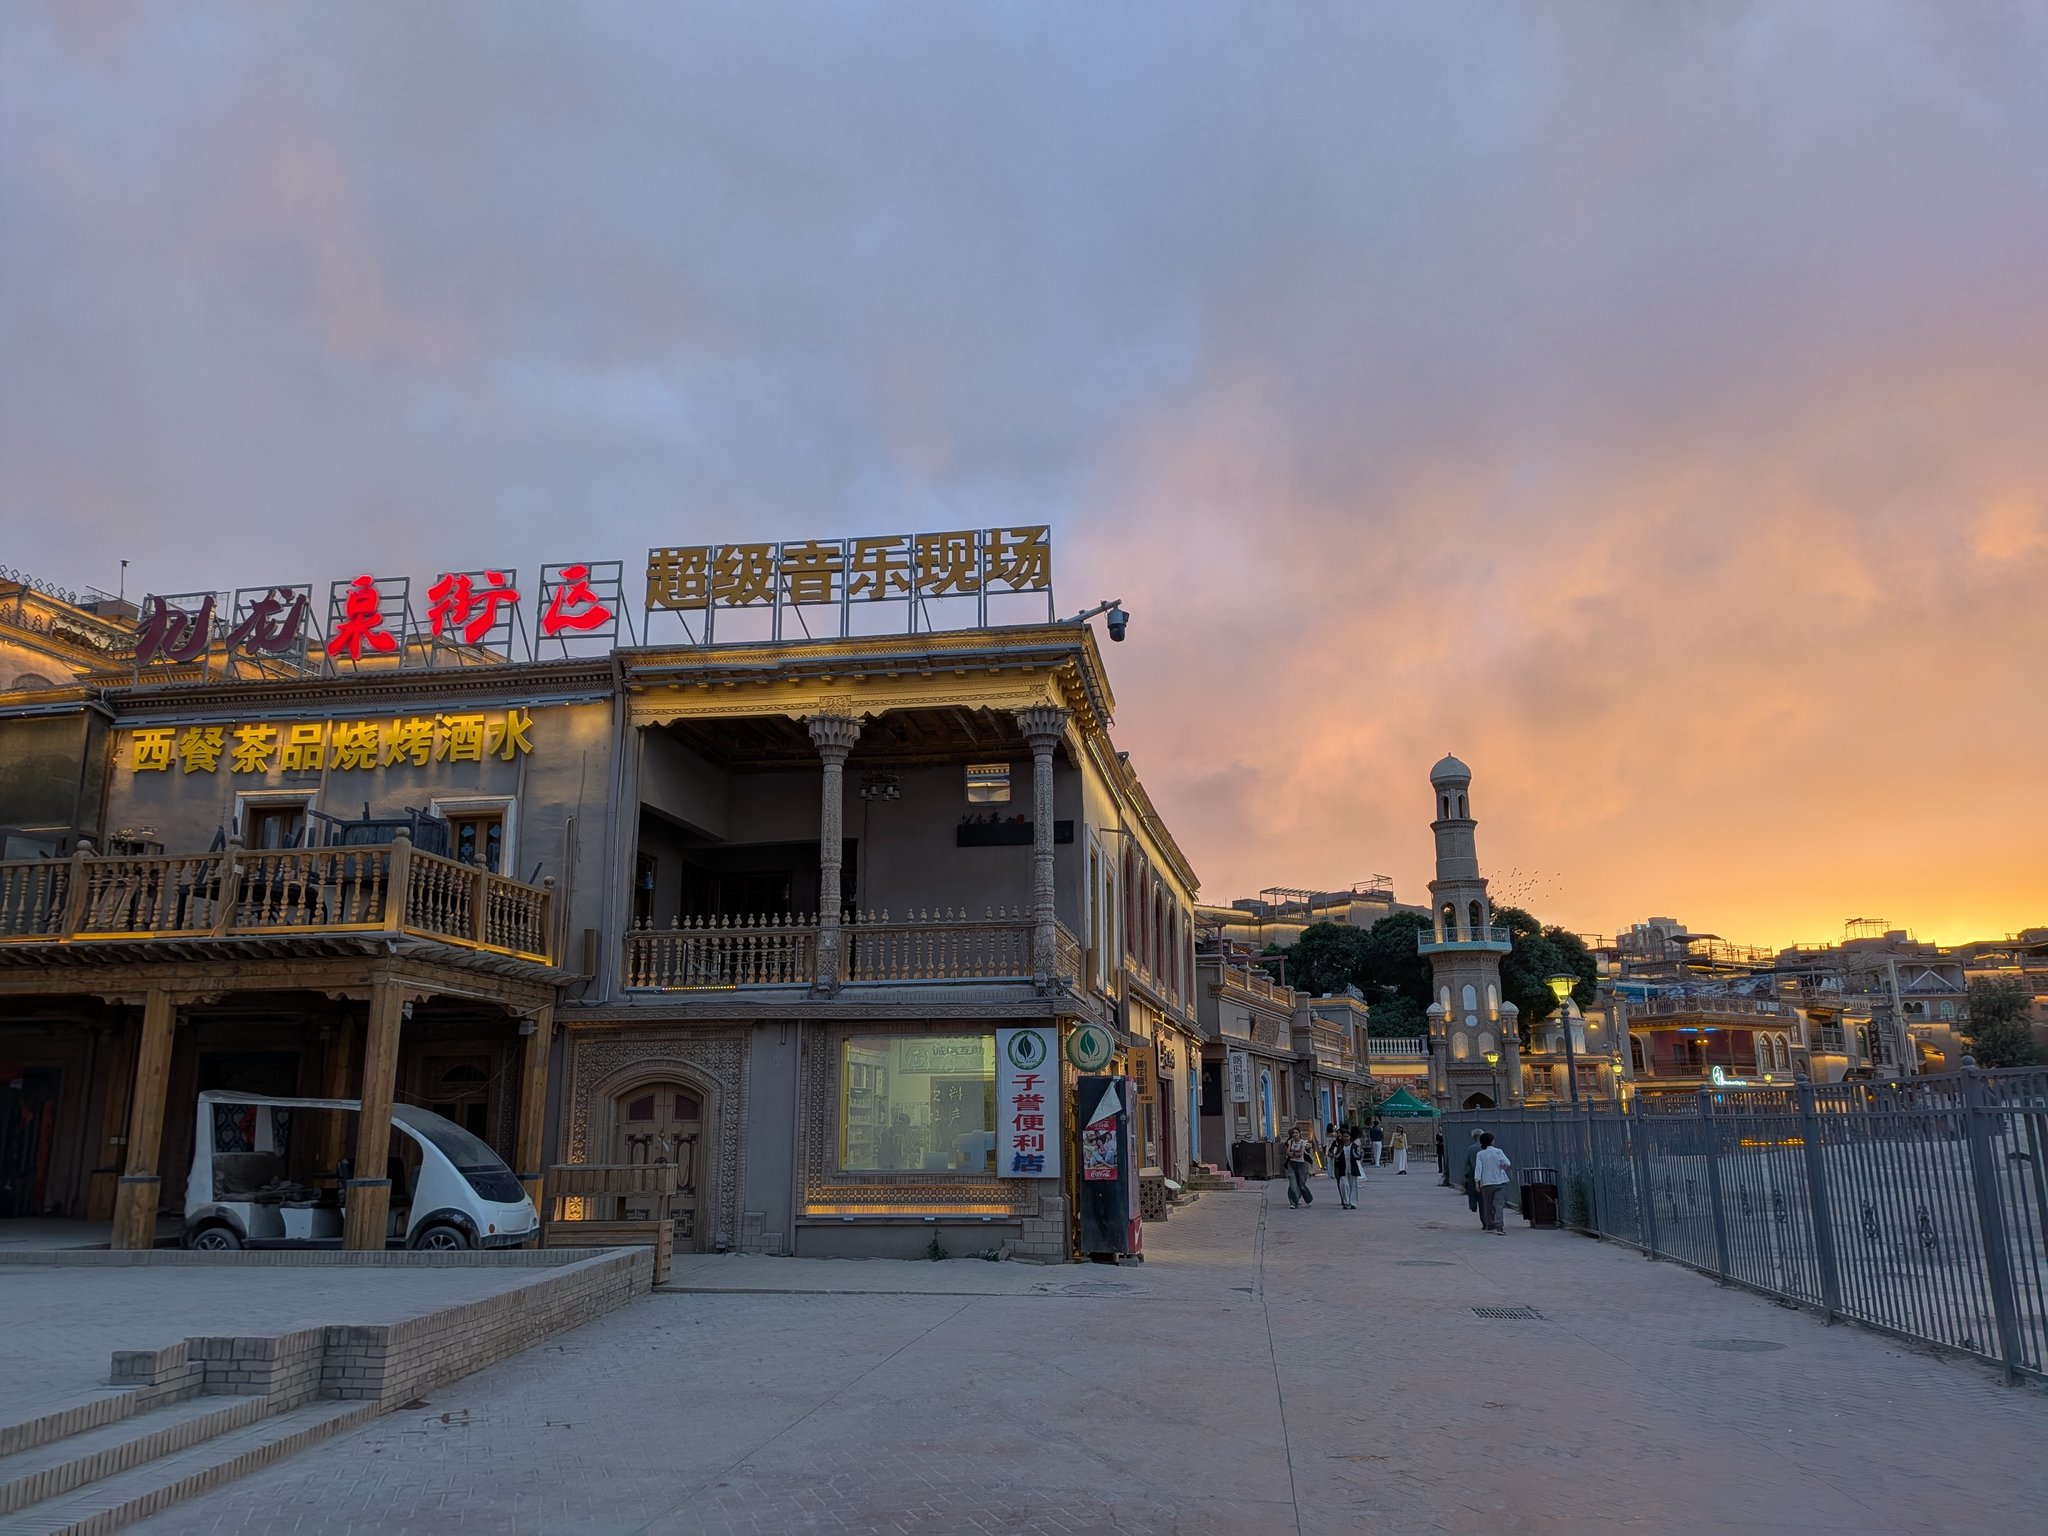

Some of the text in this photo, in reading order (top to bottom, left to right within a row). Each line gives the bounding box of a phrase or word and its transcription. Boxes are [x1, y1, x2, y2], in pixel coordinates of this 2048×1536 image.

[646, 526, 1050, 610] 超级音乐现场
[131, 708, 534, 774] 西餐茶品烧烤酒水
[1011, 1074, 1046, 1173] 子誉便利店
